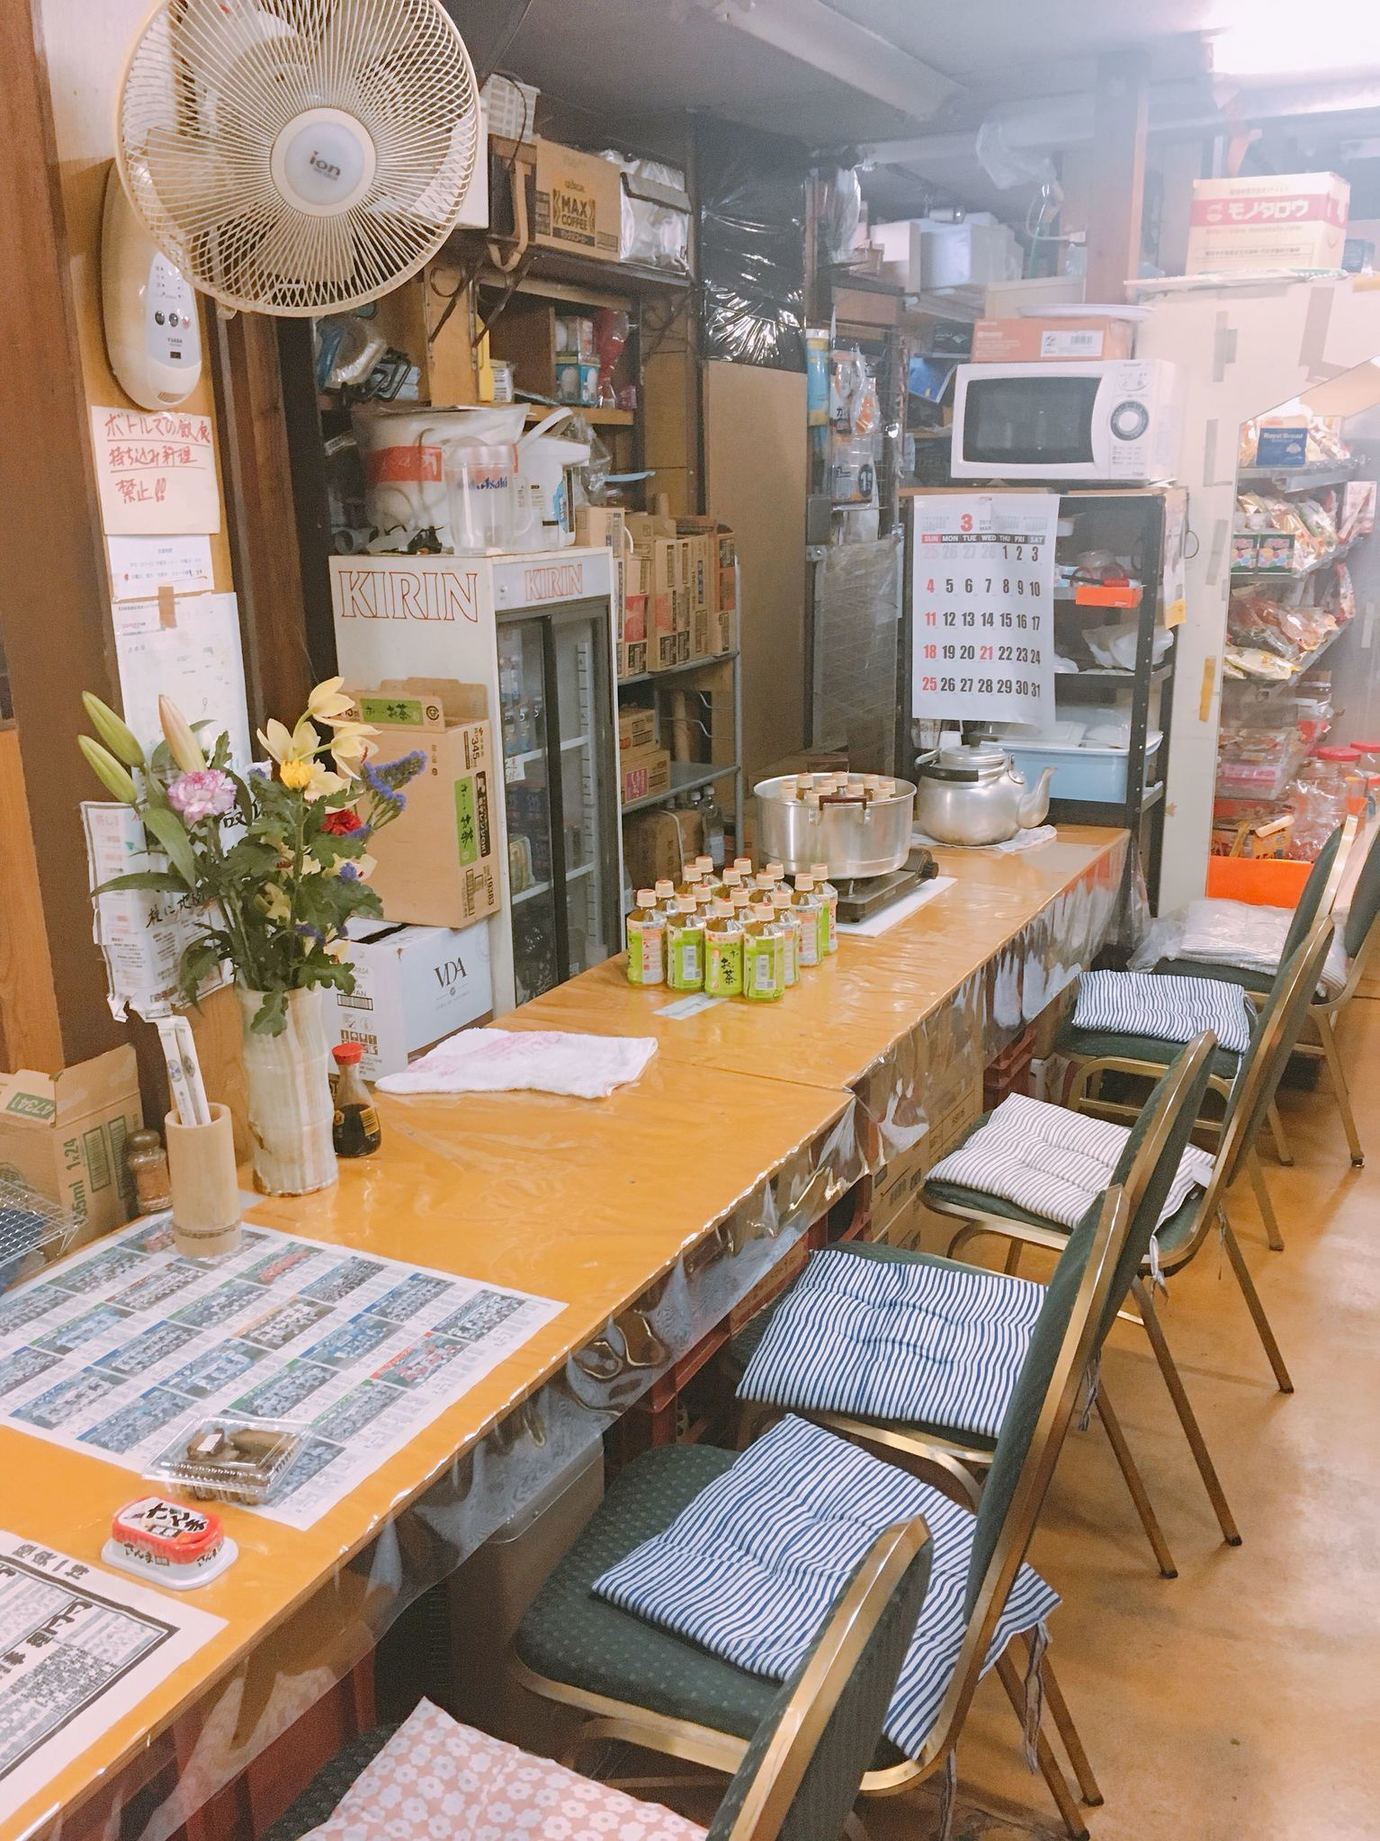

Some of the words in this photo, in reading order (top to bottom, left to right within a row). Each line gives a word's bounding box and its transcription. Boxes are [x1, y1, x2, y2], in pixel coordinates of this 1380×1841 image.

[310, 150, 341, 176] ion
[561, 195, 588, 218] MAX
[1227, 199, 1309, 220] モノタロウ
[561, 214, 588, 232] COFFEE
[476, 477, 508, 490] Asahi
[960, 513, 973, 532] 3
[981, 534, 997, 542] WED
[1002, 545, 1008, 560] 1
[1016, 546, 1023, 560] 2
[1032, 546, 1039, 562] 3
[524, 564, 583, 601] KIRIN
[927, 578, 935, 593] 4
[946, 578, 954, 593] 5
[965, 578, 973, 593] 6
[985, 578, 992, 593] 7
[1002, 578, 1010, 594] 8
[1017, 580, 1024, 595] 9
[1029, 581, 1040, 597] 10
[338, 571, 478, 622] KIRIN
[925, 611, 936, 626] 11
[943, 612, 956, 626] 12
[961, 612, 975, 627] 13
[981, 612, 994, 627] 14
[1000, 612, 1013, 627] 15
[1016, 614, 1027, 629] 16
[1032, 615, 1040, 631] 17
[924, 644, 937, 659] 18
[942, 645, 956, 659] 19
[960, 645, 975, 660] 20
[980, 645, 993, 660] 21
[998, 646, 1013, 660] 22
[1016, 647, 1028, 662] 23
[1031, 649, 1041, 664] 24
[922, 676, 937, 691] 25
[940, 677, 956, 692] 26
[960, 678, 973, 692] 27
[978, 678, 993, 693] 28
[997, 679, 1013, 694] 29
[1016, 680, 1028, 695] 30
[1031, 682, 1041, 698] 31
[472, 737, 480, 760] 345
